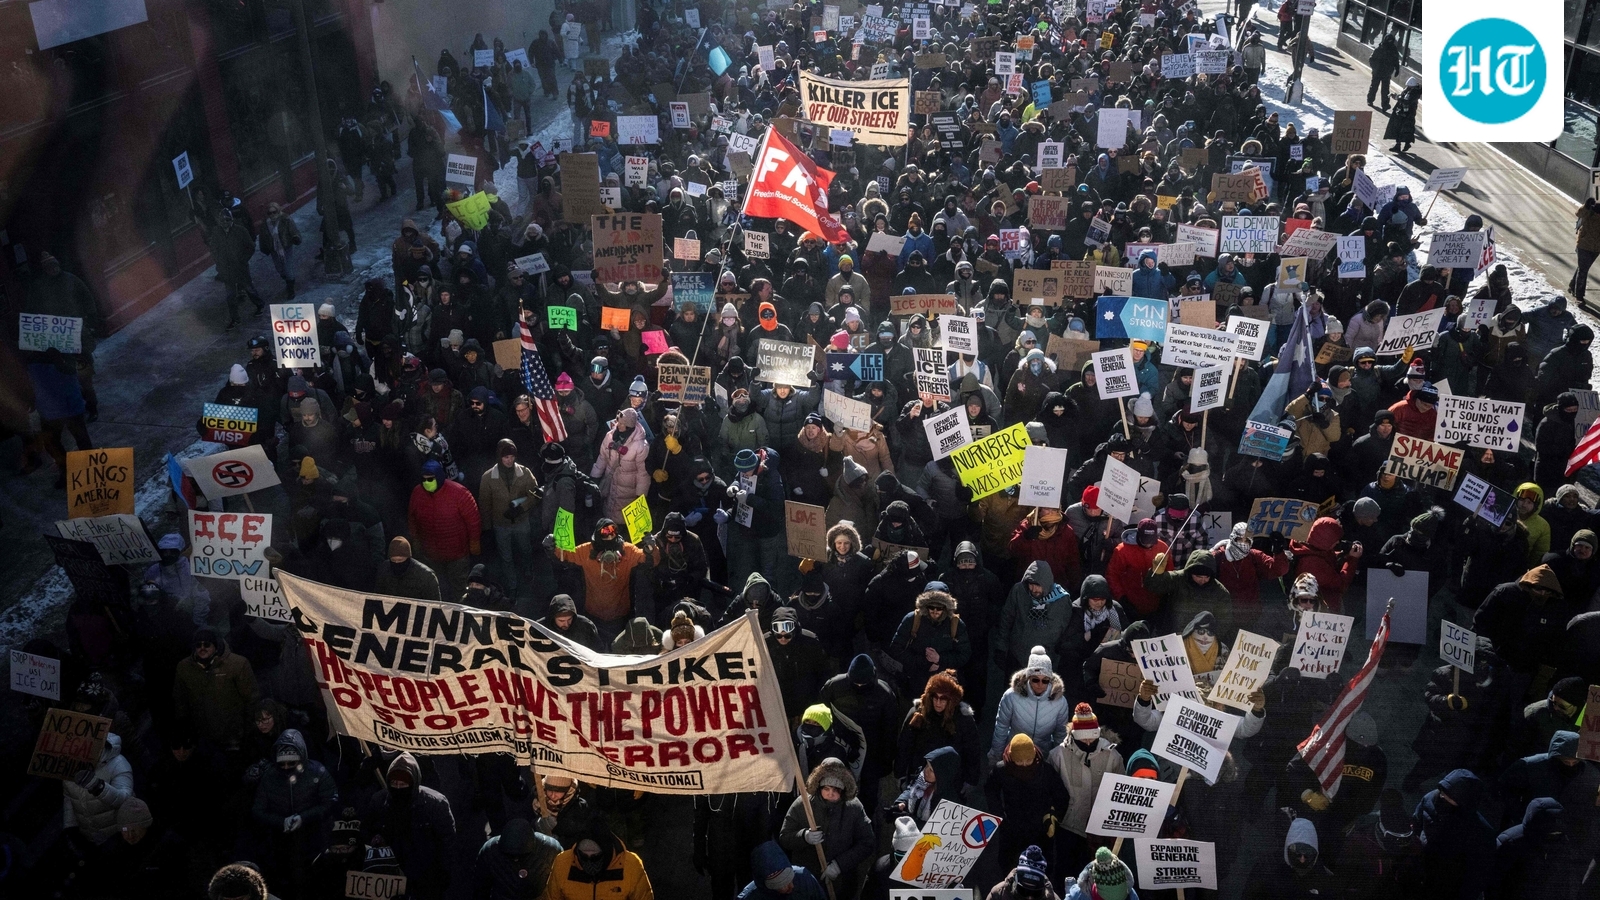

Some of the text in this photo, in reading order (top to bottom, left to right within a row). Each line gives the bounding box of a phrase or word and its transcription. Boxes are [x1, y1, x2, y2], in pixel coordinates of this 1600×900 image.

[808, 83, 899, 110] KILLER ICE
[919, 92, 938, 101] ICE
[809, 103, 899, 129] OFF OUR STREETS!
[592, 124, 608, 133] WTF
[712, 119, 730, 127] MELT
[1336, 128, 1364, 139] PRETTI
[630, 136, 648, 144] FALL
[1335, 140, 1361, 152] GOOD
[448, 161, 475, 171] HIRE CLOWNS
[627, 158, 647, 166] ALEX
[1045, 170, 1070, 179] FUCK
[1218, 177, 1251, 188] FUCK
[1222, 191, 1244, 200] ICE
[596, 216, 642, 230] THE
[1223, 217, 1279, 229] WE DEMAND
[747, 233, 766, 241] FUCK
[1001, 231, 1019, 241] ICE
[1226, 230, 1277, 241] JUSTICE for
[1432, 234, 1484, 242] IMMIGRANTS
[1001, 240, 1019, 251] OUT
[1342, 240, 1362, 250] ICE
[595, 245, 653, 258] AMENDMENT
[745, 249, 770, 258] GESTAPO
[1340, 250, 1362, 259] OUT
[618, 255, 638, 265] IS
[1052, 261, 1091, 269] ICE IS
[1436, 255, 1470, 264] GREAT!
[682, 275, 701, 283] ICE
[1095, 270, 1132, 280] MINNESOTA
[675, 282, 706, 290] AGENTS
[894, 298, 956, 311] ICE OUT NOW
[282, 306, 304, 319] ICE
[551, 308, 570, 316] FUCK
[1133, 304, 1165, 320] MN
[21, 316, 77, 328] ICE OUT
[274, 319, 311, 333] GTFO
[948, 319, 968, 328] JUSTICE
[1129, 317, 1164, 329] STRONG
[1236, 321, 1260, 331] JUSTICE
[1403, 313, 1433, 330] OPE
[22, 324, 76, 335] CBP OUT
[947, 325, 970, 334] FOR ALEX
[1245, 330, 1260, 338] ALEX
[23, 332, 74, 341] JUSTICE
[278, 336, 313, 346] DONCHA
[1381, 330, 1435, 351] MURDER
[281, 347, 317, 360] KNOW?
[760, 342, 813, 357] YOU CAN'T BE
[917, 348, 943, 363] KILLER
[1100, 355, 1114, 364] EXPAND
[661, 366, 706, 377] DETAIN THE
[916, 361, 948, 376] ICE
[1101, 361, 1126, 373] GENERAL
[659, 376, 710, 386] REAL TRASH!
[931, 376, 948, 384] OUR
[1105, 375, 1128, 386] STRIKE!
[1201, 369, 1223, 381] EXPAND THE
[1199, 376, 1222, 388] GENERAL
[1445, 409, 1501, 425] IT SOUNDS
[203, 417, 256, 432] ICE OUT
[1451, 420, 1506, 435] LIKE WHEN
[213, 431, 244, 443] MSP
[89, 452, 108, 466] NO
[1394, 436, 1461, 470] SHAME
[988, 459, 1004, 470] 2.0
[1415, 459, 1435, 467] ON
[71, 466, 128, 491] KINGS
[1467, 478, 1476, 486] Hey
[74, 487, 119, 508] AMERICA
[1259, 500, 1304, 520] ICE
[789, 509, 817, 526] LOVE
[194, 514, 265, 547] ICE
[1254, 519, 1303, 537] OUT
[109, 547, 153, 561] A KING
[202, 545, 253, 559] OUT
[790, 543, 815, 556] WINS
[194, 556, 264, 576] NOW
[263, 594, 284, 607] LA
[1305, 631, 1347, 646] was an
[1445, 624, 1470, 645] ICE
[1297, 642, 1340, 659] Asylum
[1443, 641, 1474, 667] OUT!!
[15, 673, 59, 695] ICE OUT!
[303, 637, 359, 691] THE
[357, 667, 489, 712] PEOPLE
[567, 691, 635, 743] THE
[641, 685, 767, 740] POWER
[1179, 706, 1224, 730] EXPAND THE
[47, 714, 108, 740] NO ONE
[1175, 714, 1219, 740] GENERAL
[39, 735, 95, 761] ILLEGAL
[1172, 733, 1210, 760] STRIKE!
[1167, 743, 1185, 755] ICE
[1186, 750, 1209, 767] OUT!
[606, 763, 700, 786] @PSLNATIONAL
[1114, 782, 1160, 798] EXPAND THE
[933, 800, 970, 822] FUCK
[923, 819, 966, 837] ICE!
[1103, 819, 1121, 827] ICE
[1121, 821, 1147, 829] OUT!
[942, 840, 968, 854] AND
[1150, 844, 1200, 854] EXPAND THE
[1151, 852, 1200, 863] GENERAL
[930, 863, 965, 875] DUSTY
[1155, 867, 1198, 877] STRIKE!
[348, 874, 403, 898] ICE OUT
